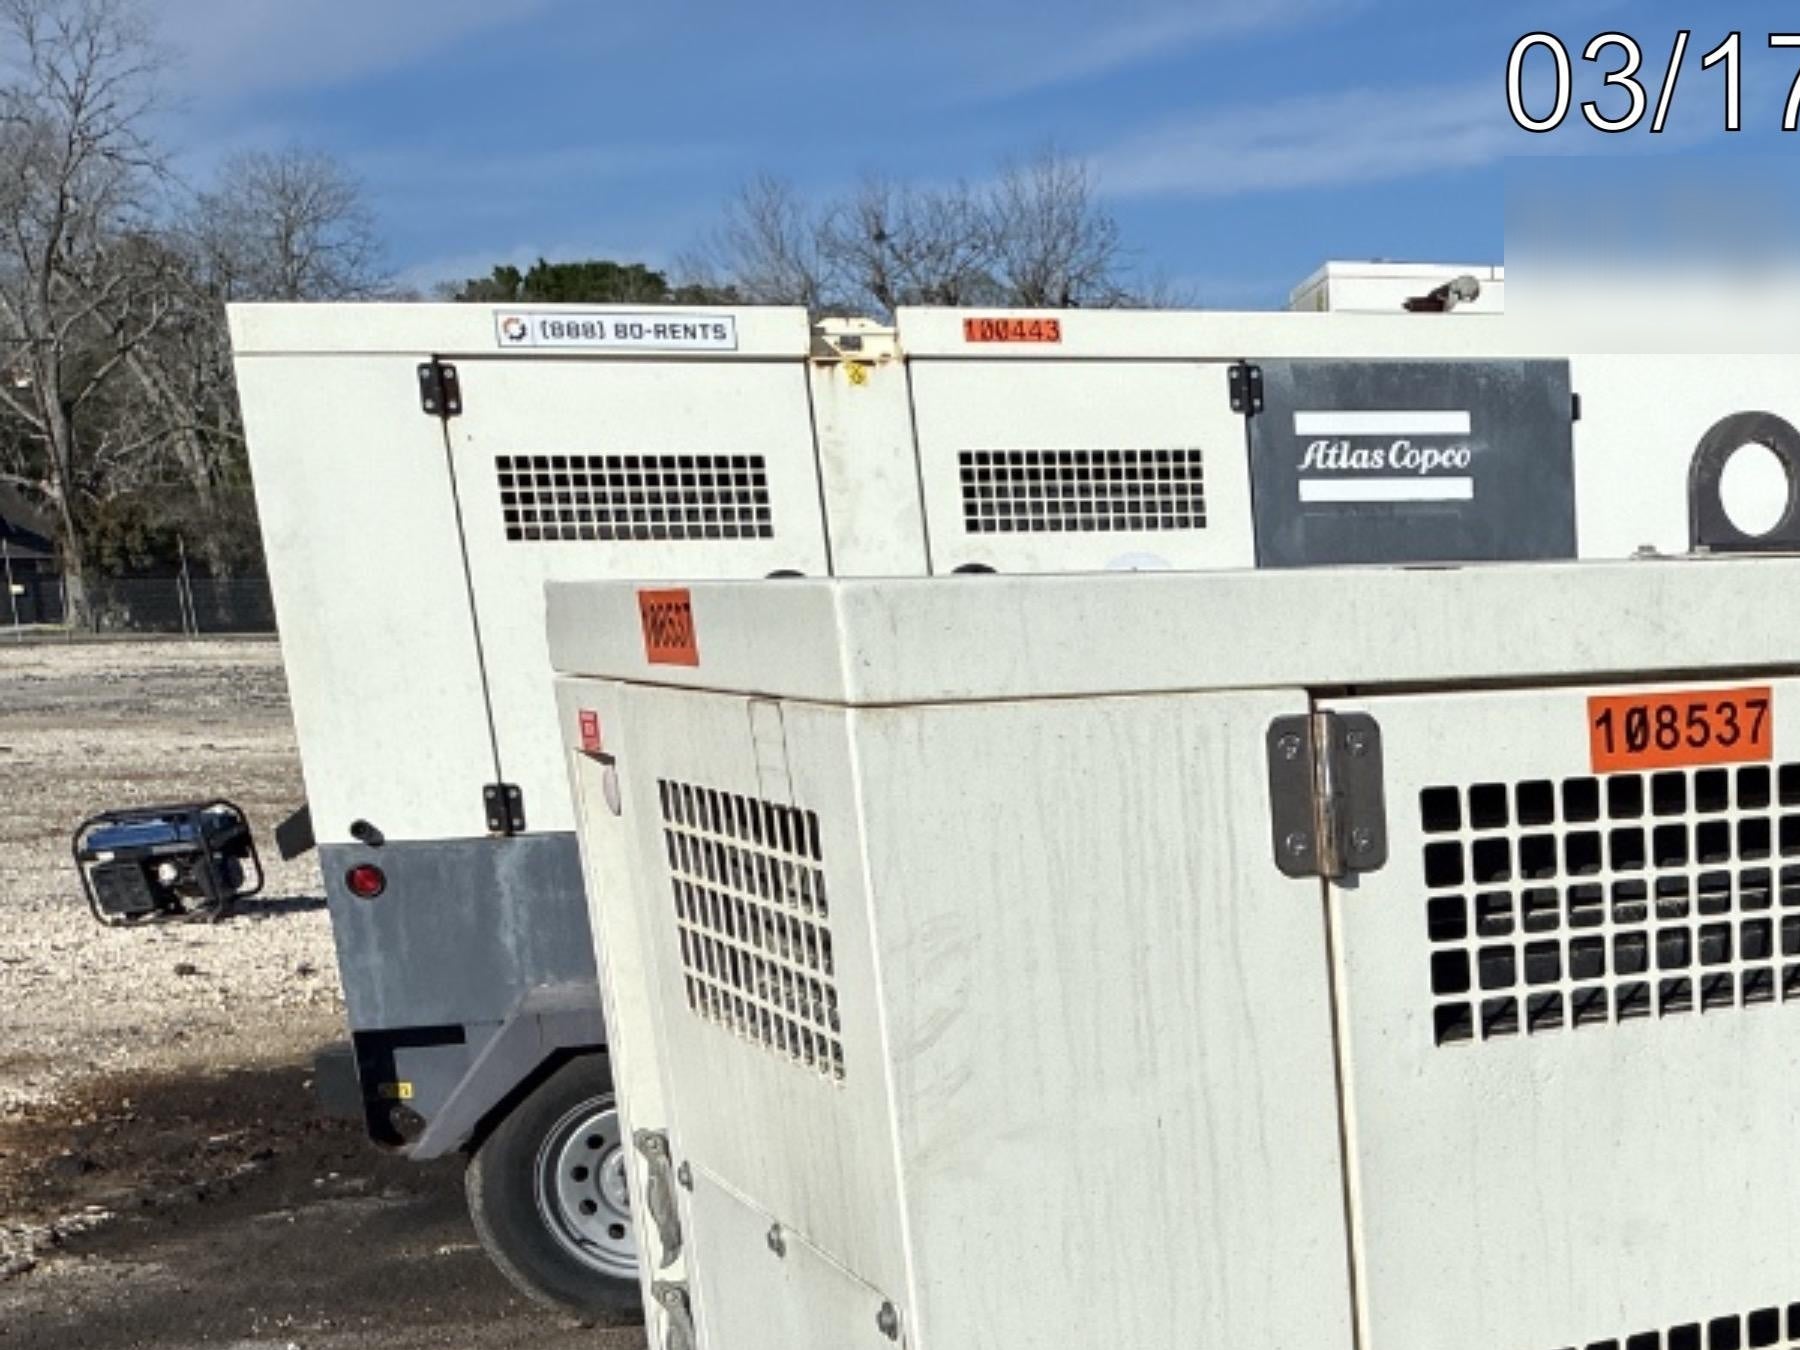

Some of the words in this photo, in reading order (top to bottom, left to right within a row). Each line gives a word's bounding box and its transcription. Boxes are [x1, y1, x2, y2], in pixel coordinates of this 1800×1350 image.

[1297, 440, 1385, 470] Atlas
[1388, 440, 1471, 474] Copco
[1595, 699, 1768, 753] 108537
